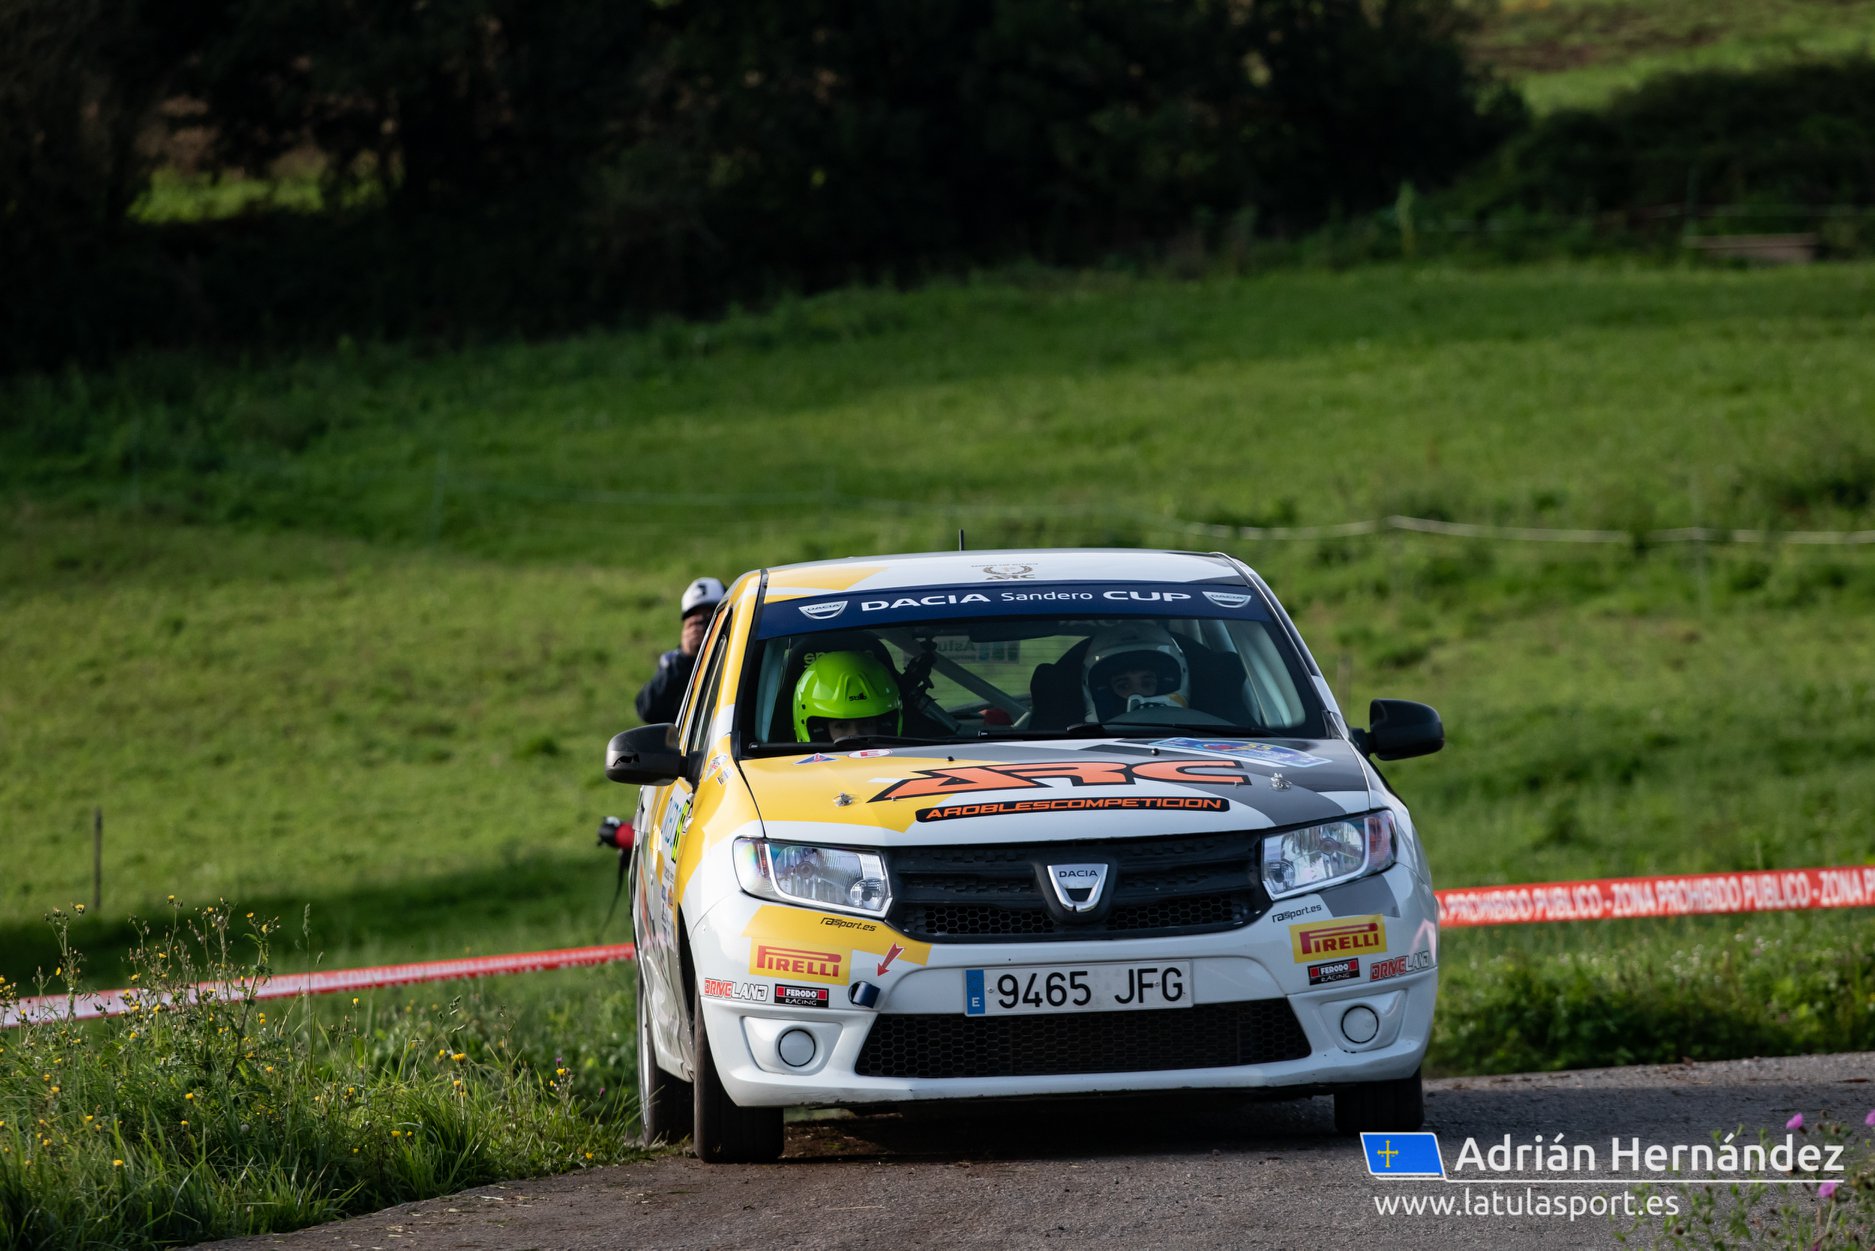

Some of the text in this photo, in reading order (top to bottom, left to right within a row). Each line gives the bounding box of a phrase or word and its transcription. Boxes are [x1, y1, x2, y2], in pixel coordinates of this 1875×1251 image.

[861, 591, 1191, 611] DACIA Sandero CUP
[867, 760, 1252, 803] ARC
[926, 798, 1222, 819] AROBLESCOMPETICION
[1058, 870, 1098, 878] DACIA
[1611, 881, 1655, 916] ZONA
[1655, 875, 1742, 915] PROHIBIDO
[1742, 871, 1810, 910] PUBLICO
[1818, 869, 1863, 906] ZONA
[1272, 904, 1322, 923] rasport.es
[820, 916, 877, 932] rasport.es
[1299, 922, 1379, 955] PIRELLI
[756, 945, 842, 977] PIRELLI
[1320, 963, 1350, 976] FERODO
[997, 966, 1183, 1009] 9465 JFG
[1320, 973, 1351, 983] RACING
[785, 987, 818, 999] FERODO
[785, 998, 818, 1006] RACING
[971, 996, 981, 1008] E
